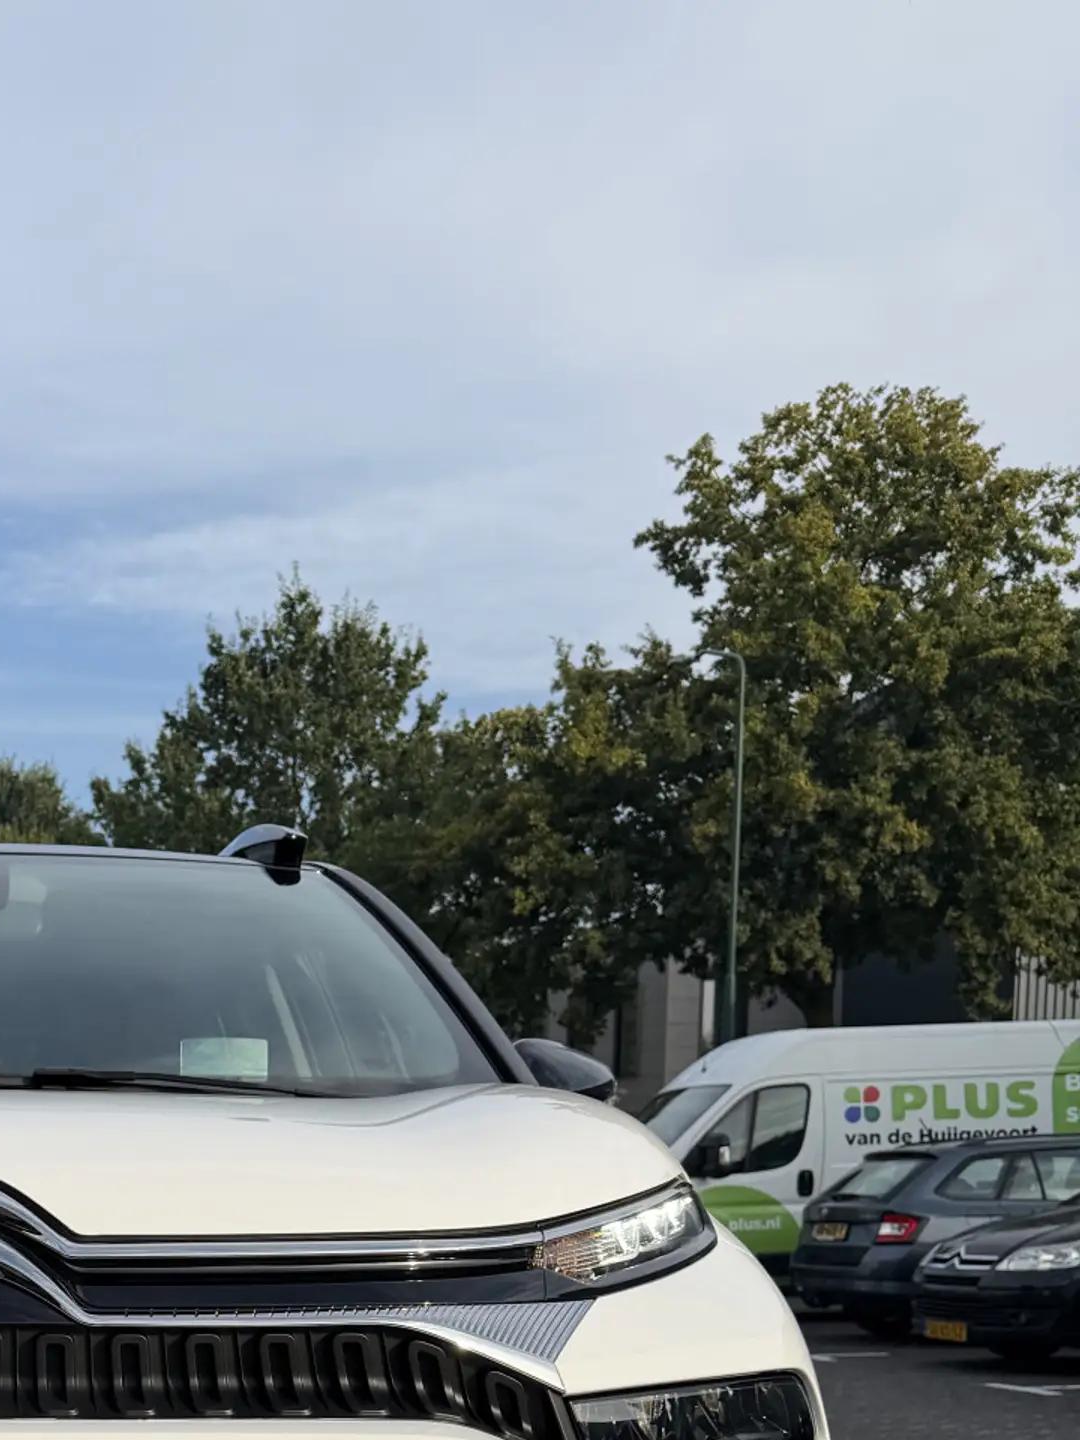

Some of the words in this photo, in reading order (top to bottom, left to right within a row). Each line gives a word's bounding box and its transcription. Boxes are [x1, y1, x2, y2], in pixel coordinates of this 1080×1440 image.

[891, 1081, 1038, 1122] PLUS
[845, 1132, 882, 1146] van
[888, 1127, 912, 1145] de
